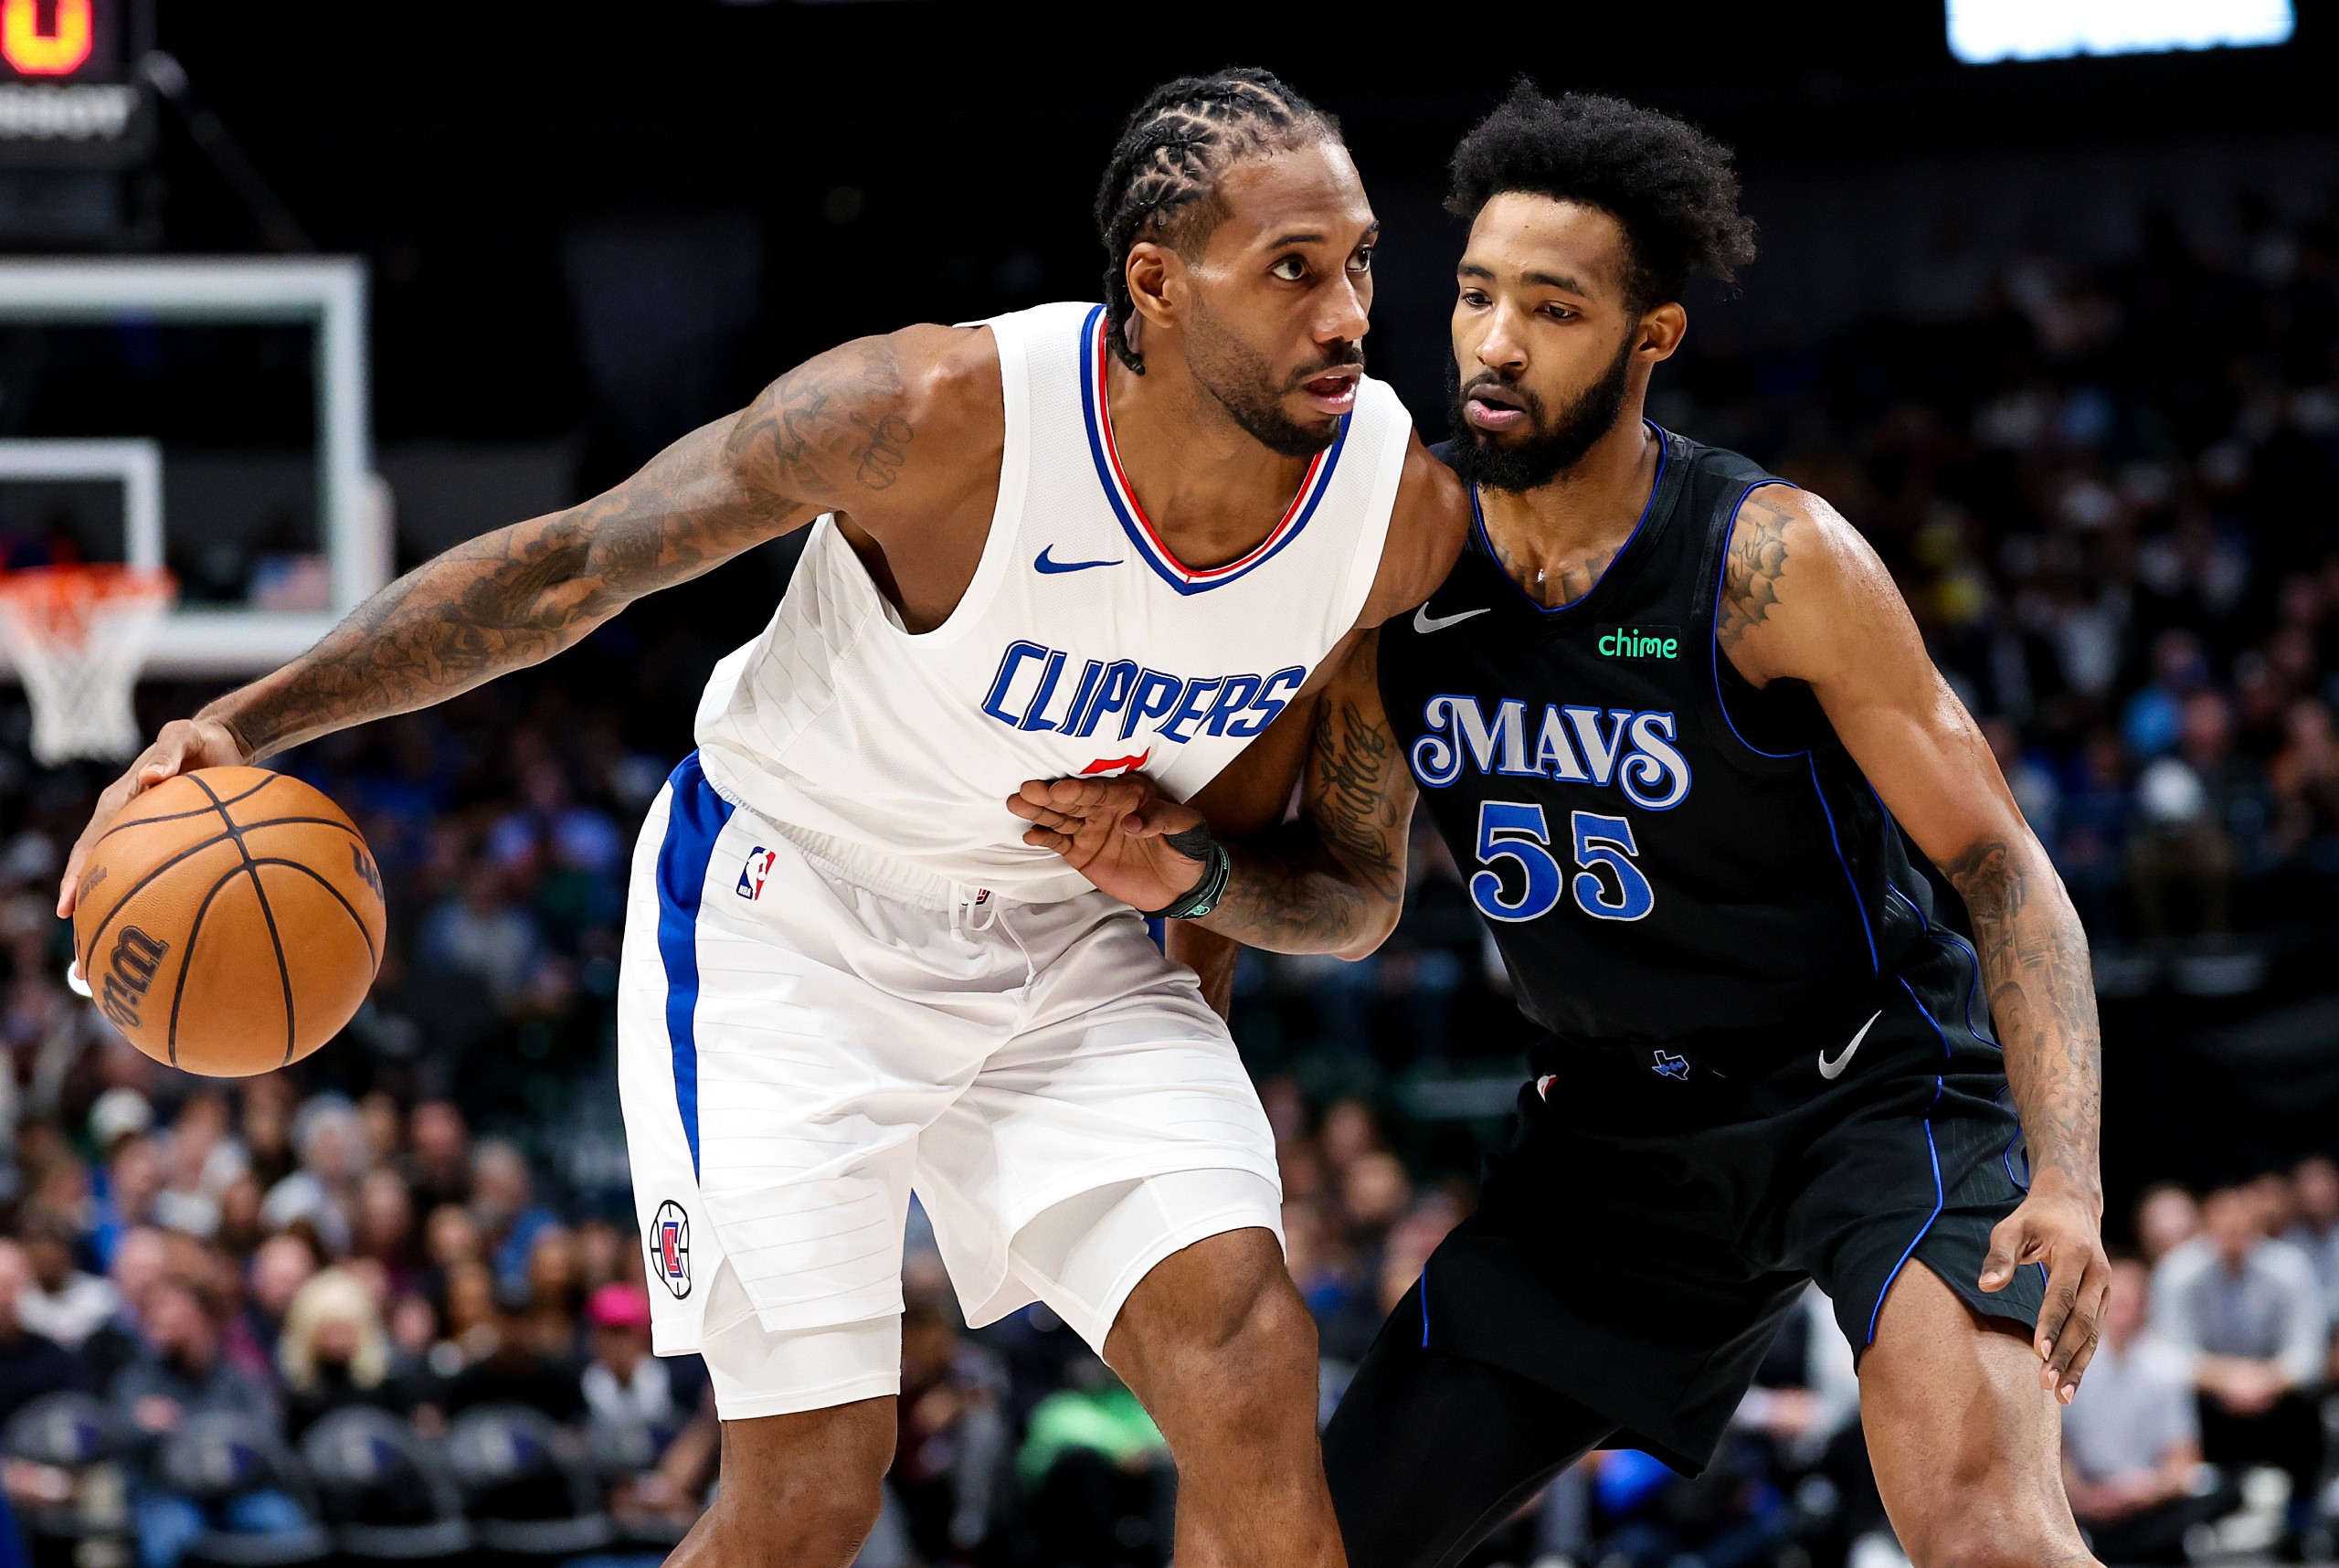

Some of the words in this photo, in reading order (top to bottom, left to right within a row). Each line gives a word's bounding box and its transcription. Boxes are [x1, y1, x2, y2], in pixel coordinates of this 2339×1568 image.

[981, 640, 1307, 744] CLIPPERS
[1599, 628, 1678, 659] chime
[1411, 694, 1691, 810] MAVS
[1470, 800, 1655, 923] 55
